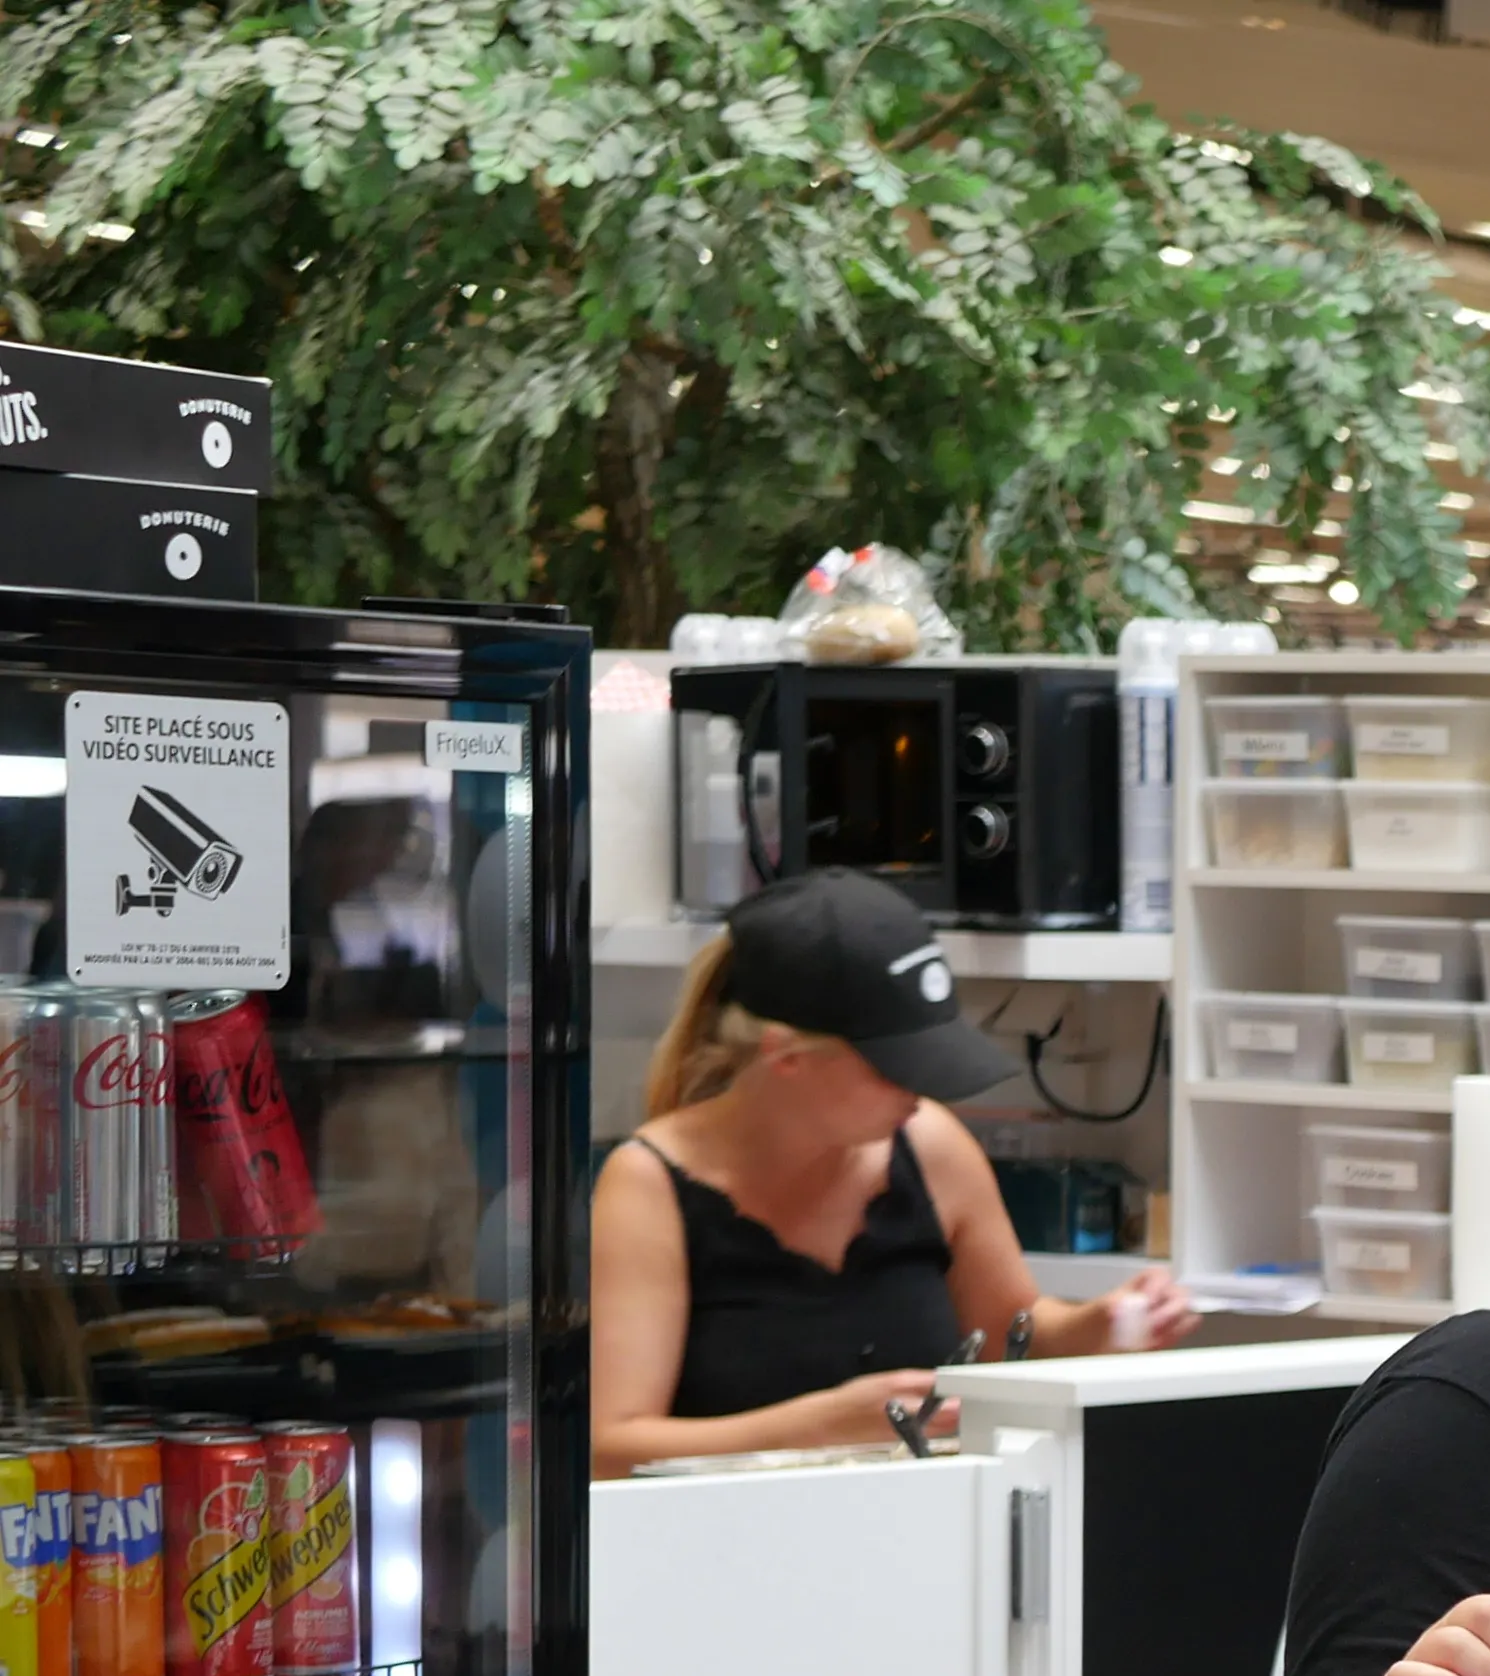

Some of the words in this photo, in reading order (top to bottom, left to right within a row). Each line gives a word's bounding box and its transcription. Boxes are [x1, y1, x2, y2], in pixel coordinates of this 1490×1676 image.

[179, 398, 252, 426] DONUTERIE
[139, 510, 231, 537] DONUTERIE
[104, 715, 142, 735] SITE
[147, 715, 203, 739] PLACÉ
[207, 721, 255, 742] SOUS
[83, 737, 140, 762] VIDÉO
[144, 744, 276, 769] SURVEILLANCE
